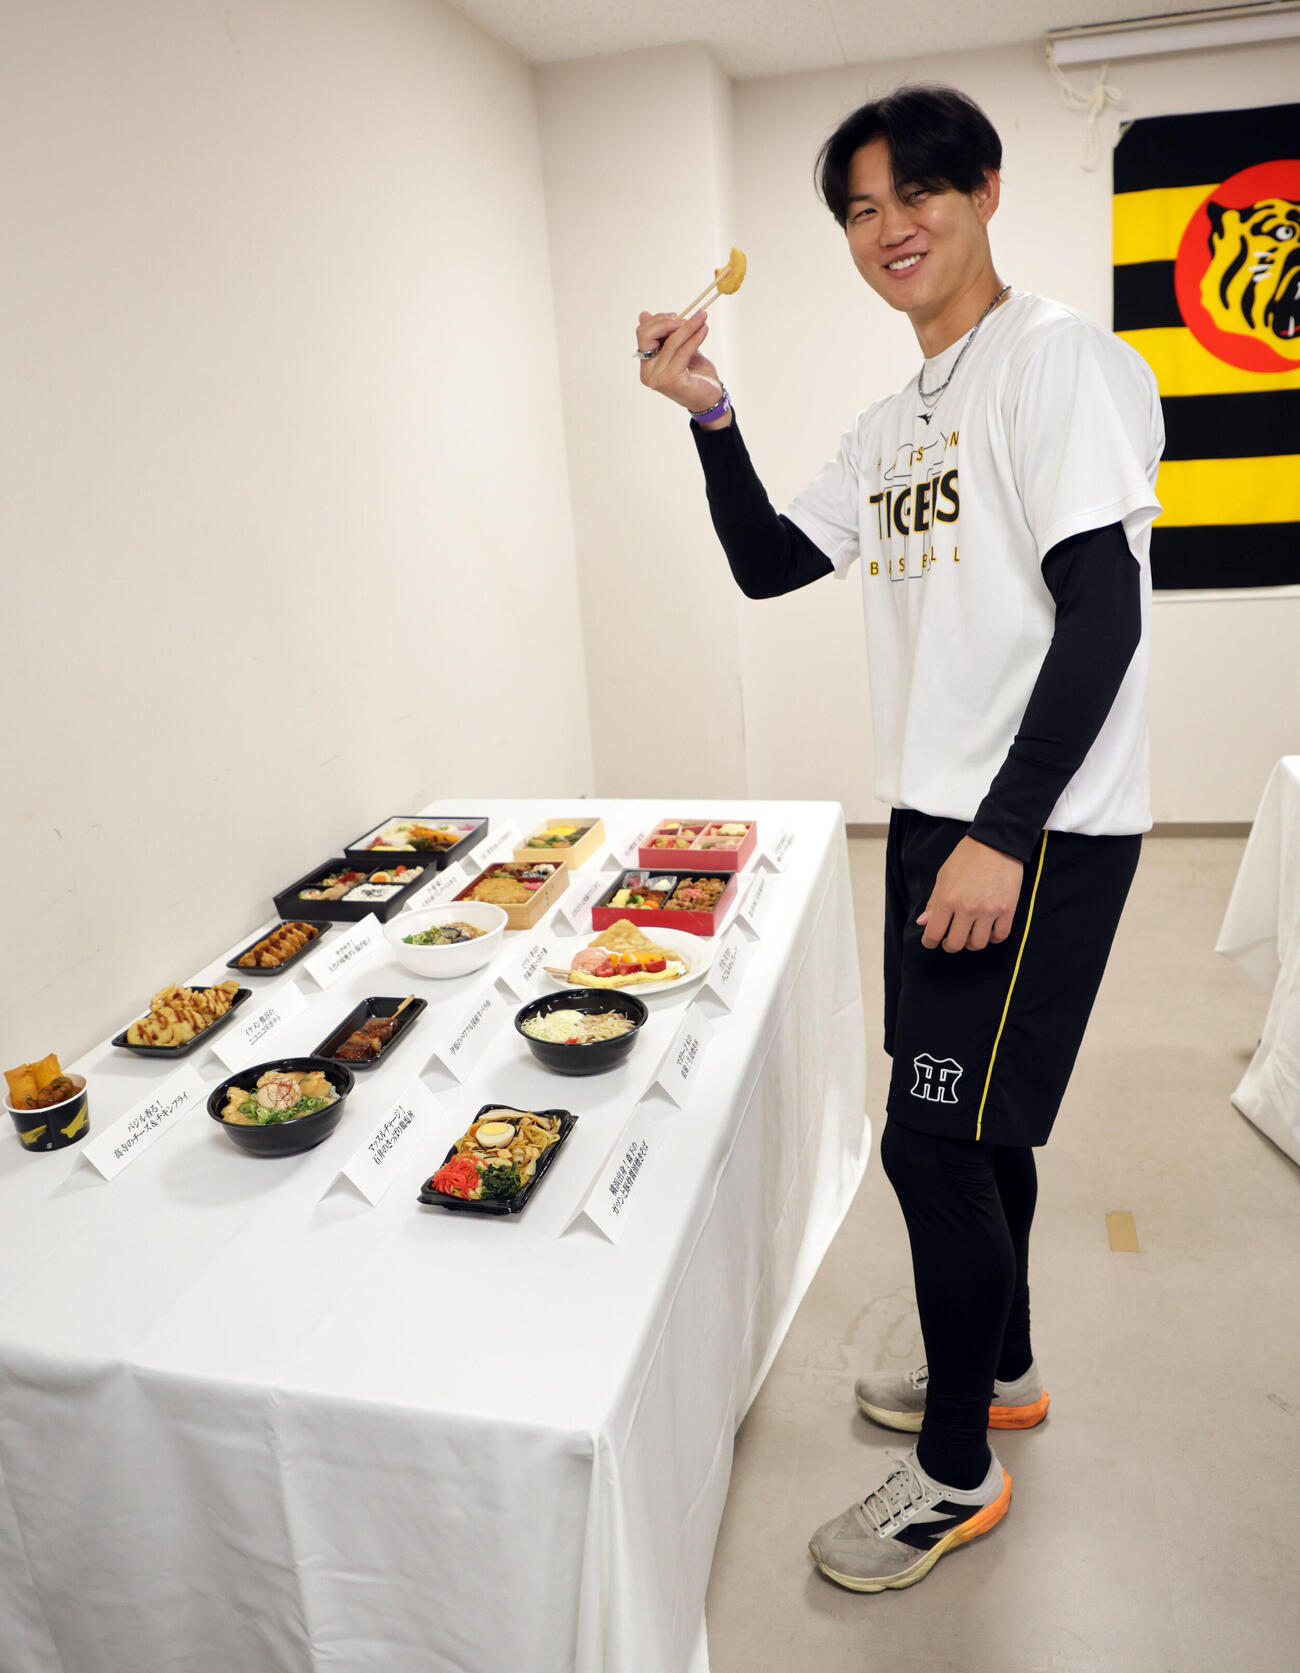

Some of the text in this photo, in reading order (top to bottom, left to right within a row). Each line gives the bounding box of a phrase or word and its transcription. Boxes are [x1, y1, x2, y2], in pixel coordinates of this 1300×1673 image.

[127, 1100, 163, 1132] バジル香る！
[368, 1105, 406, 1151] マッスルチャージ！
